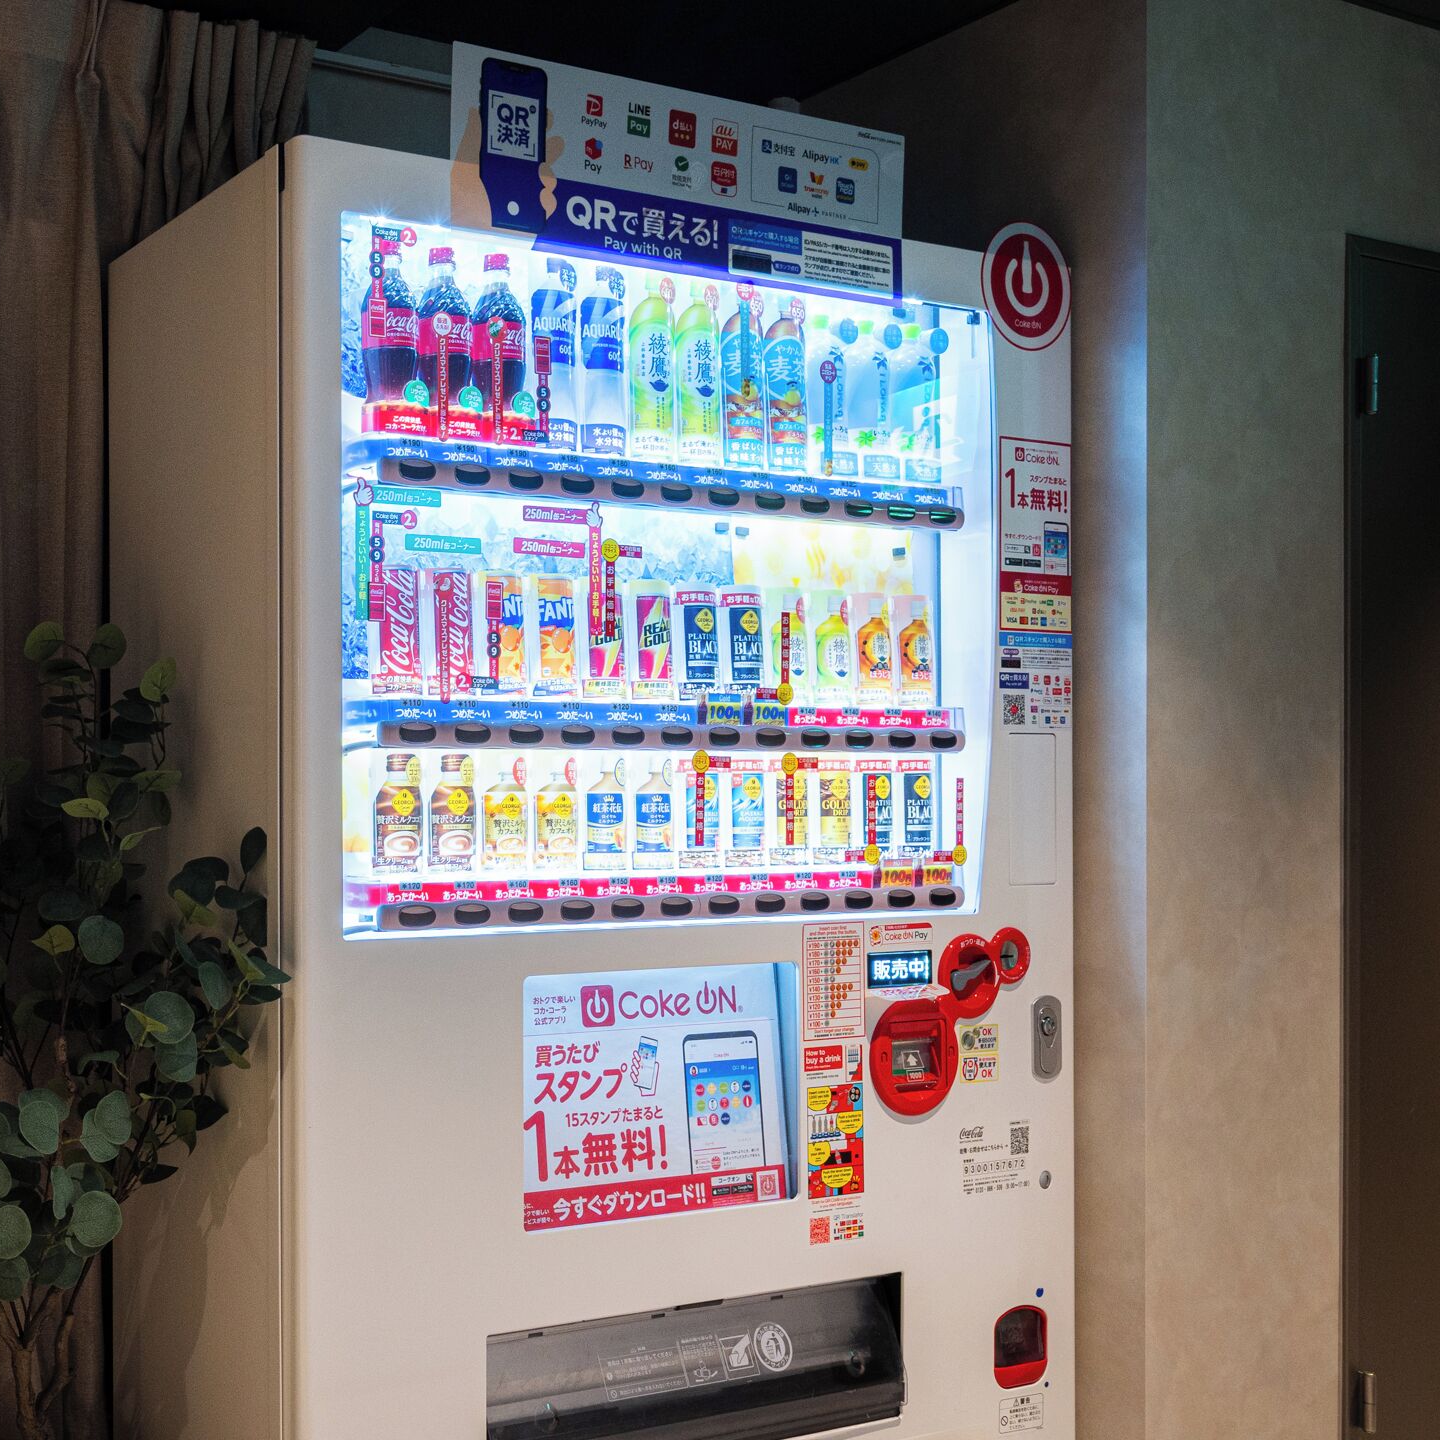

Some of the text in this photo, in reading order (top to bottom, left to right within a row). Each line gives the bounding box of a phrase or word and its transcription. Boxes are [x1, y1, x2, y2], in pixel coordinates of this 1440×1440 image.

[497, 103, 529, 127] QR
[628, 102, 651, 116] LINE
[581, 116, 607, 129] PayPay
[630, 121, 648, 134] Pay
[497, 124, 530, 149] 決済
[716, 125, 735, 136] au
[716, 139, 734, 151] PAY
[773, 143, 795, 157] 支付宝
[584, 160, 602, 174] Pay
[634, 157, 654, 173] Pay
[604, 236, 682, 260] Pay with QR
[1015, 318, 1041, 329] Coke ON
[648, 333, 668, 379] 綾鷹
[695, 340, 713, 384] 綾鷹
[402, 439, 420, 447] ¥190
[1026, 453, 1045, 463] Coke
[1030, 475, 1067, 486] スタンプたまると
[376, 490, 440, 503] 250ml缶コーナー
[525, 508, 583, 521] 250ml缶コーナー
[414, 538, 476, 551] 250ml缶コーナー
[521, 541, 580, 554] 250ml缶コーナー
[1048, 586, 1059, 595] Pay
[884, 930, 928, 941] Coke ON Pay
[873, 957, 923, 980] 販売中
[533, 995, 576, 1006] おトクで楽しい
[618, 988, 691, 1020] Coke
[534, 1016, 566, 1025] 公式アプリ
[982, 1028, 992, 1036] OK
[535, 1041, 600, 1068] 買うたび
[806, 1057, 818, 1065] buy
[981, 1069, 992, 1078] OK
[534, 1063, 628, 1105] スタンプ
[565, 1105, 664, 1128] 15スタンプたまると
[959, 1126, 984, 1140] Coca-Cola
[718, 1175, 740, 1184] コークオン
